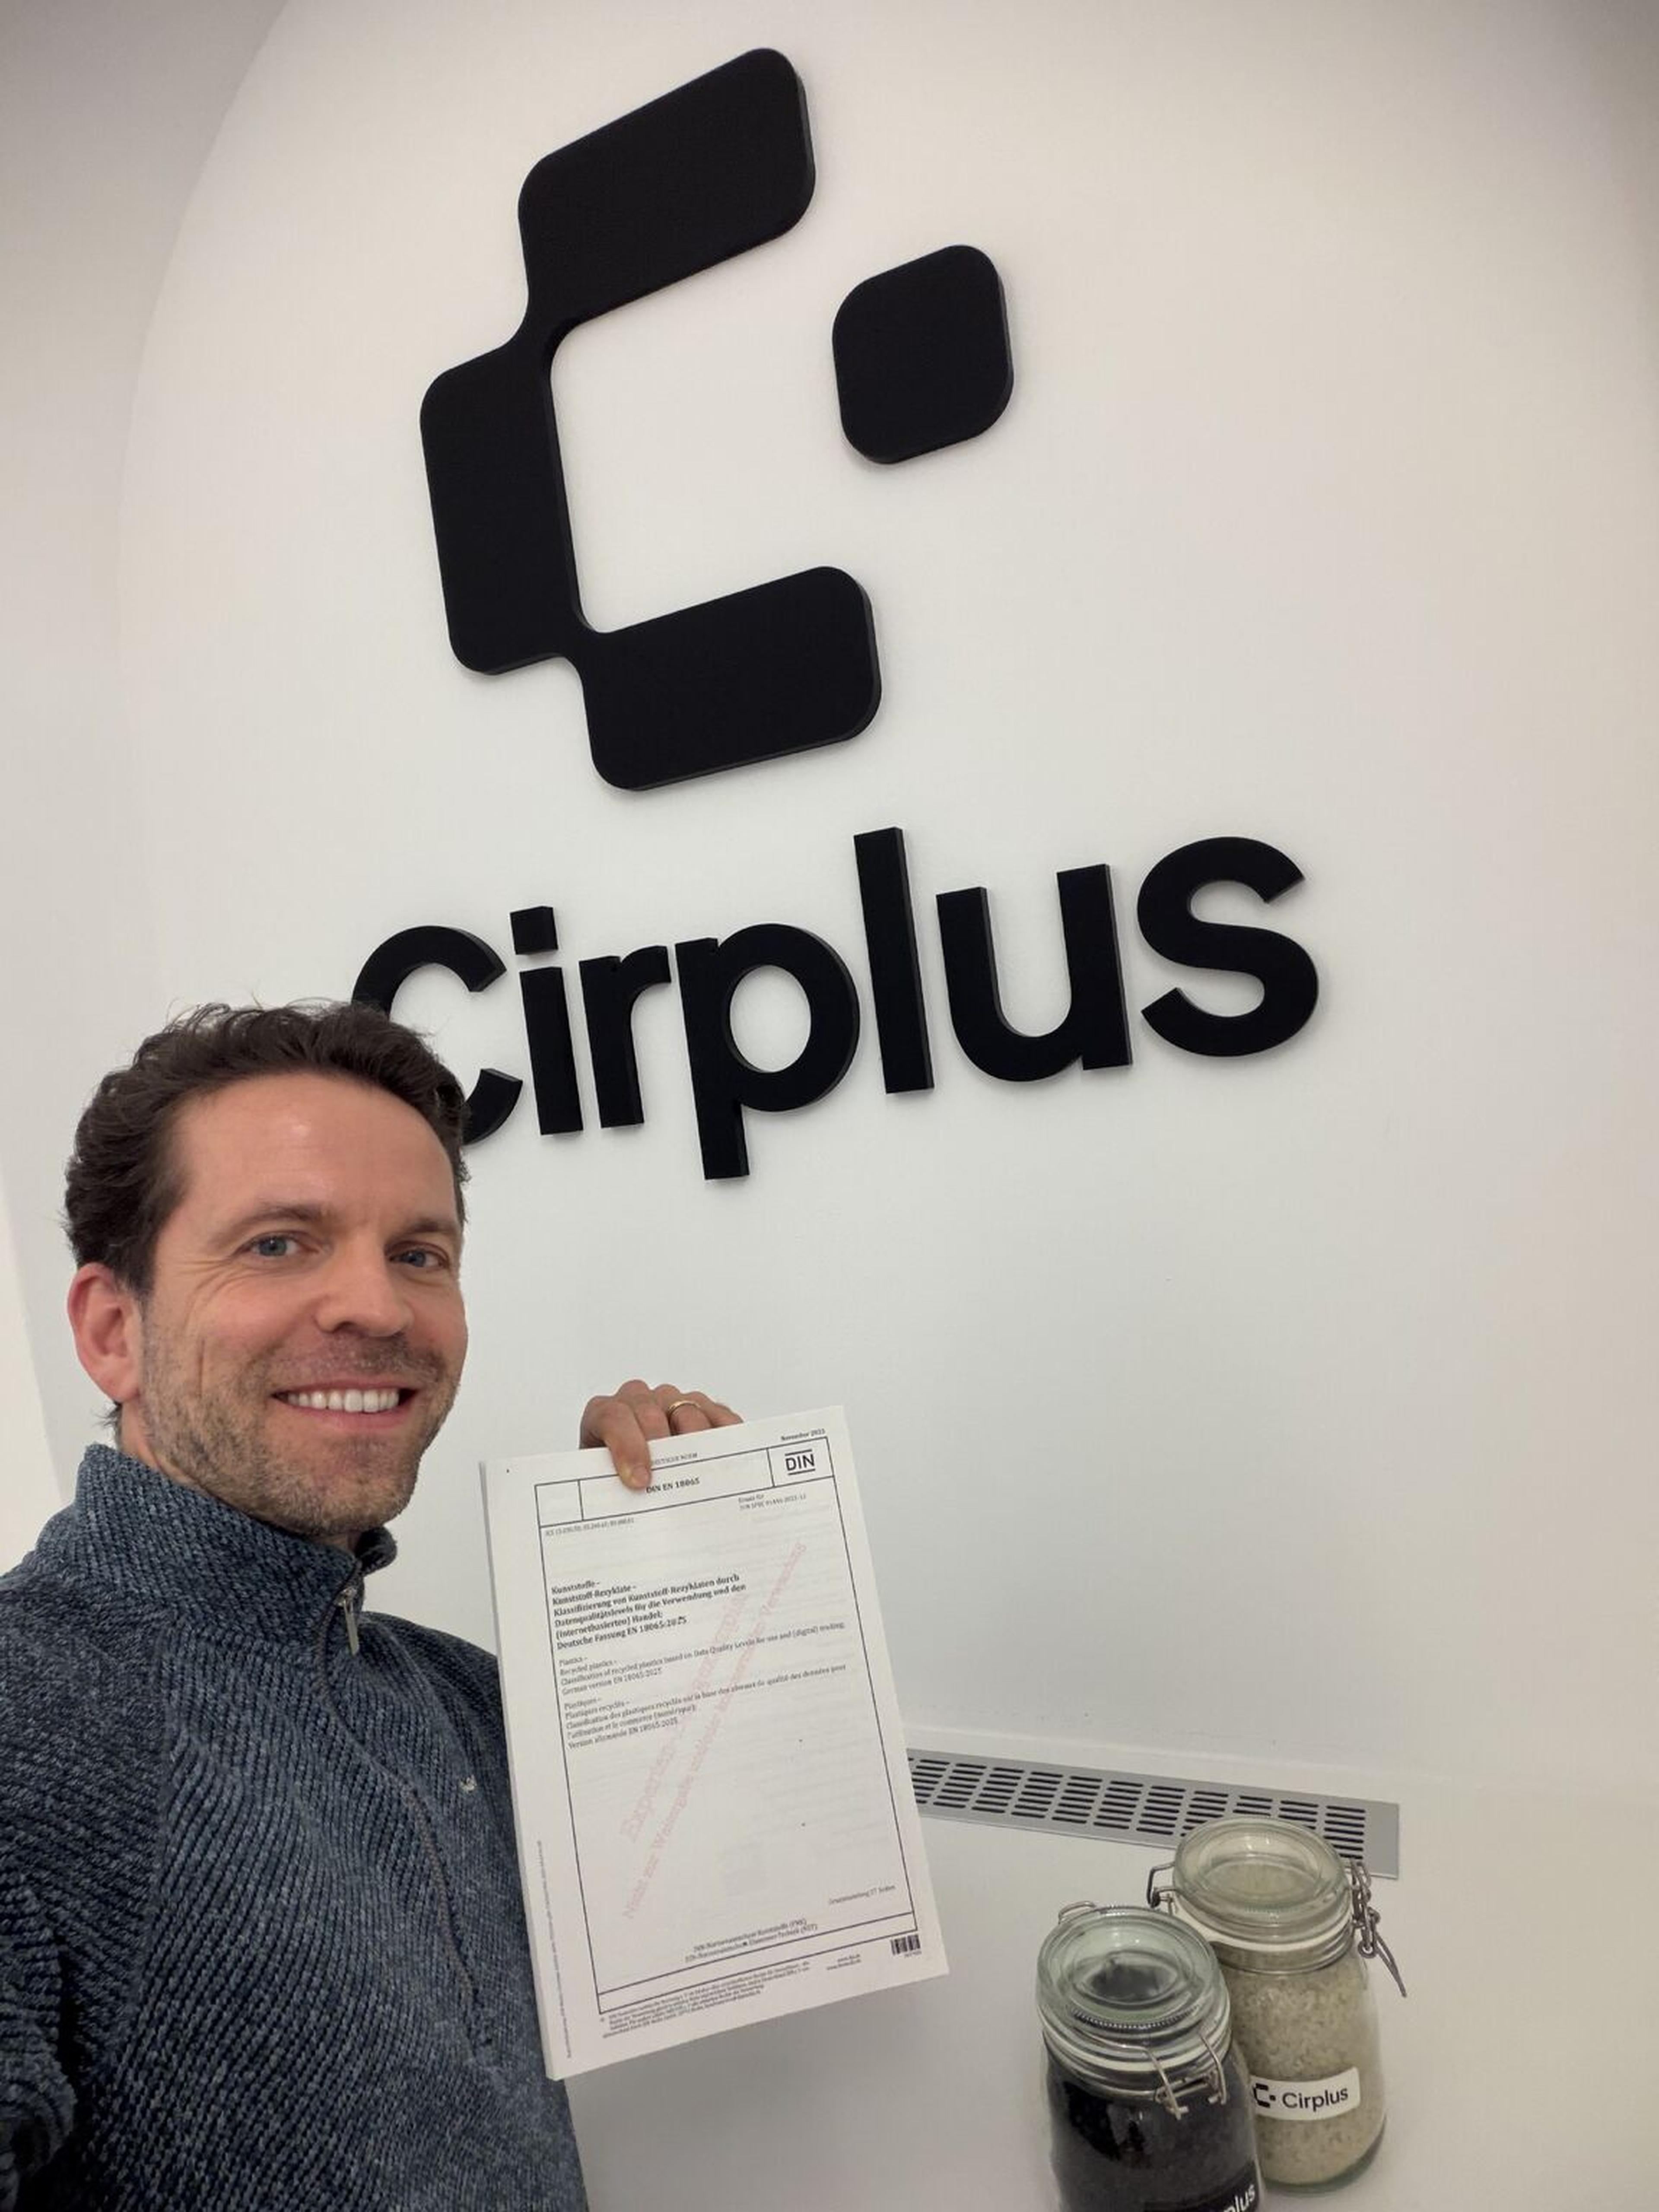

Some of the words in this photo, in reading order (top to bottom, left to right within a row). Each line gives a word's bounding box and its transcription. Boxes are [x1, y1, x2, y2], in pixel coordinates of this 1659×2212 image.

[351, 827, 1319, 1179] Cirplus
[780, 1431, 809, 1441] November
[785, 1453, 815, 1471] DIN
[645, 1484, 661, 1493] DIN
[662, 1482, 674, 1491] EN
[674, 1477, 700, 1488] 18065
[550, 1579, 595, 1595] Kunststoffe
[552, 1583, 631, 1608] Kunststoff-Rezyklate
[553, 1599, 611, 1618] Klassifizierung
[613, 1597, 626, 1605] von
[628, 1578, 715, 1603] Kunststoff-Rezyklaten
[715, 1573, 740, 1585] durch
[554, 1605, 633, 1629] Datenqualitätslevels
[634, 1602, 646, 1612] für
[647, 1599, 661, 1609] die
[661, 1589, 712, 1607] Verwendung
[713, 1586, 729, 1595] und
[730, 1583, 746, 1593] den
[555, 1616, 631, 1640] (internetbasierten)
[631, 1610, 663, 1623] Handel;
[556, 1635, 594, 1649] Deutsche
[594, 1628, 626, 1643] Fassung
[626, 1626, 638, 1635] EN
[558, 1656, 583, 1666] Plastics
[559, 1663, 588, 1677] Recycled
[588, 1659, 613, 1672] plastics
[560, 1670, 604, 1686] Classification
[611, 1663, 637, 1675] recycled
[638, 1657, 663, 1669] plastics
[664, 1653, 683, 1663] based
[693, 1647, 709, 1657] Data
[709, 1642, 733, 1655] Quality
[734, 1638, 755, 1649] Levels
[756, 1636, 765, 1644] for
[779, 1630, 792, 1639] and
[562, 1683, 587, 1695] German
[588, 1679, 612, 1689] version
[613, 1675, 623, 1684] EN
[563, 1697, 597, 1711] Plastiques
[566, 1714, 609, 1729] Classification
[609, 1710, 621, 1719] des
[621, 1703, 655, 1717] plastiques
[701, 1688, 717, 1698] base
[717, 1686, 729, 1695] des
[766, 1673, 789, 1686] qualité
[789, 1671, 801, 1680] des
[565, 1706, 598, 1720] Plastiques
[619, 1714, 653, 1727] commerce
[568, 1737, 594, 1749] Version
[594, 1729, 628, 1743] allemande
[628, 1725, 639, 1735] EN
[1282, 2088, 1348, 2111] Cirplus
